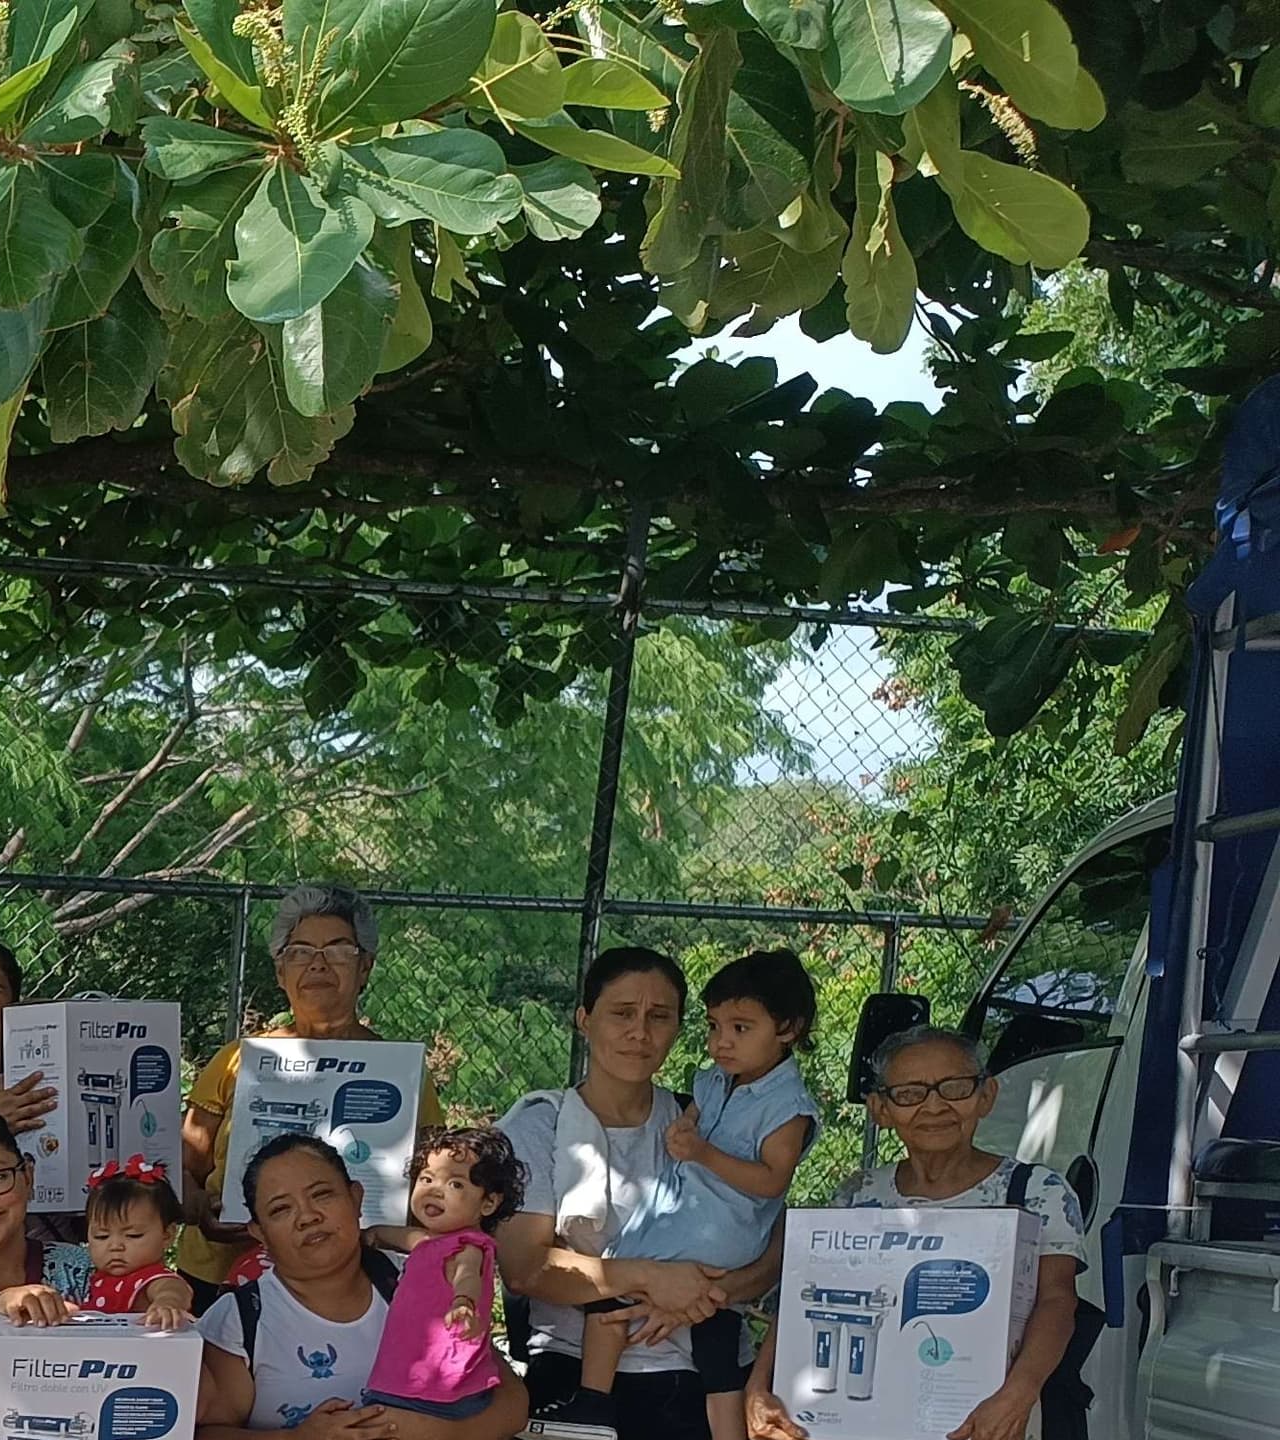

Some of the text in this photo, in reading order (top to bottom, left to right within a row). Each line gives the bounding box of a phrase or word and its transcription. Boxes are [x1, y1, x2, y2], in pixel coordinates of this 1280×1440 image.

[80, 1021, 147, 1038] FilterPro
[259, 1055, 366, 1073] FilterPro
[810, 1230, 944, 1251] FilterPro
[12, 1358, 138, 1379] FilterPro
[40, 1383, 67, 1393] doble
[70, 1384, 89, 1393] con
